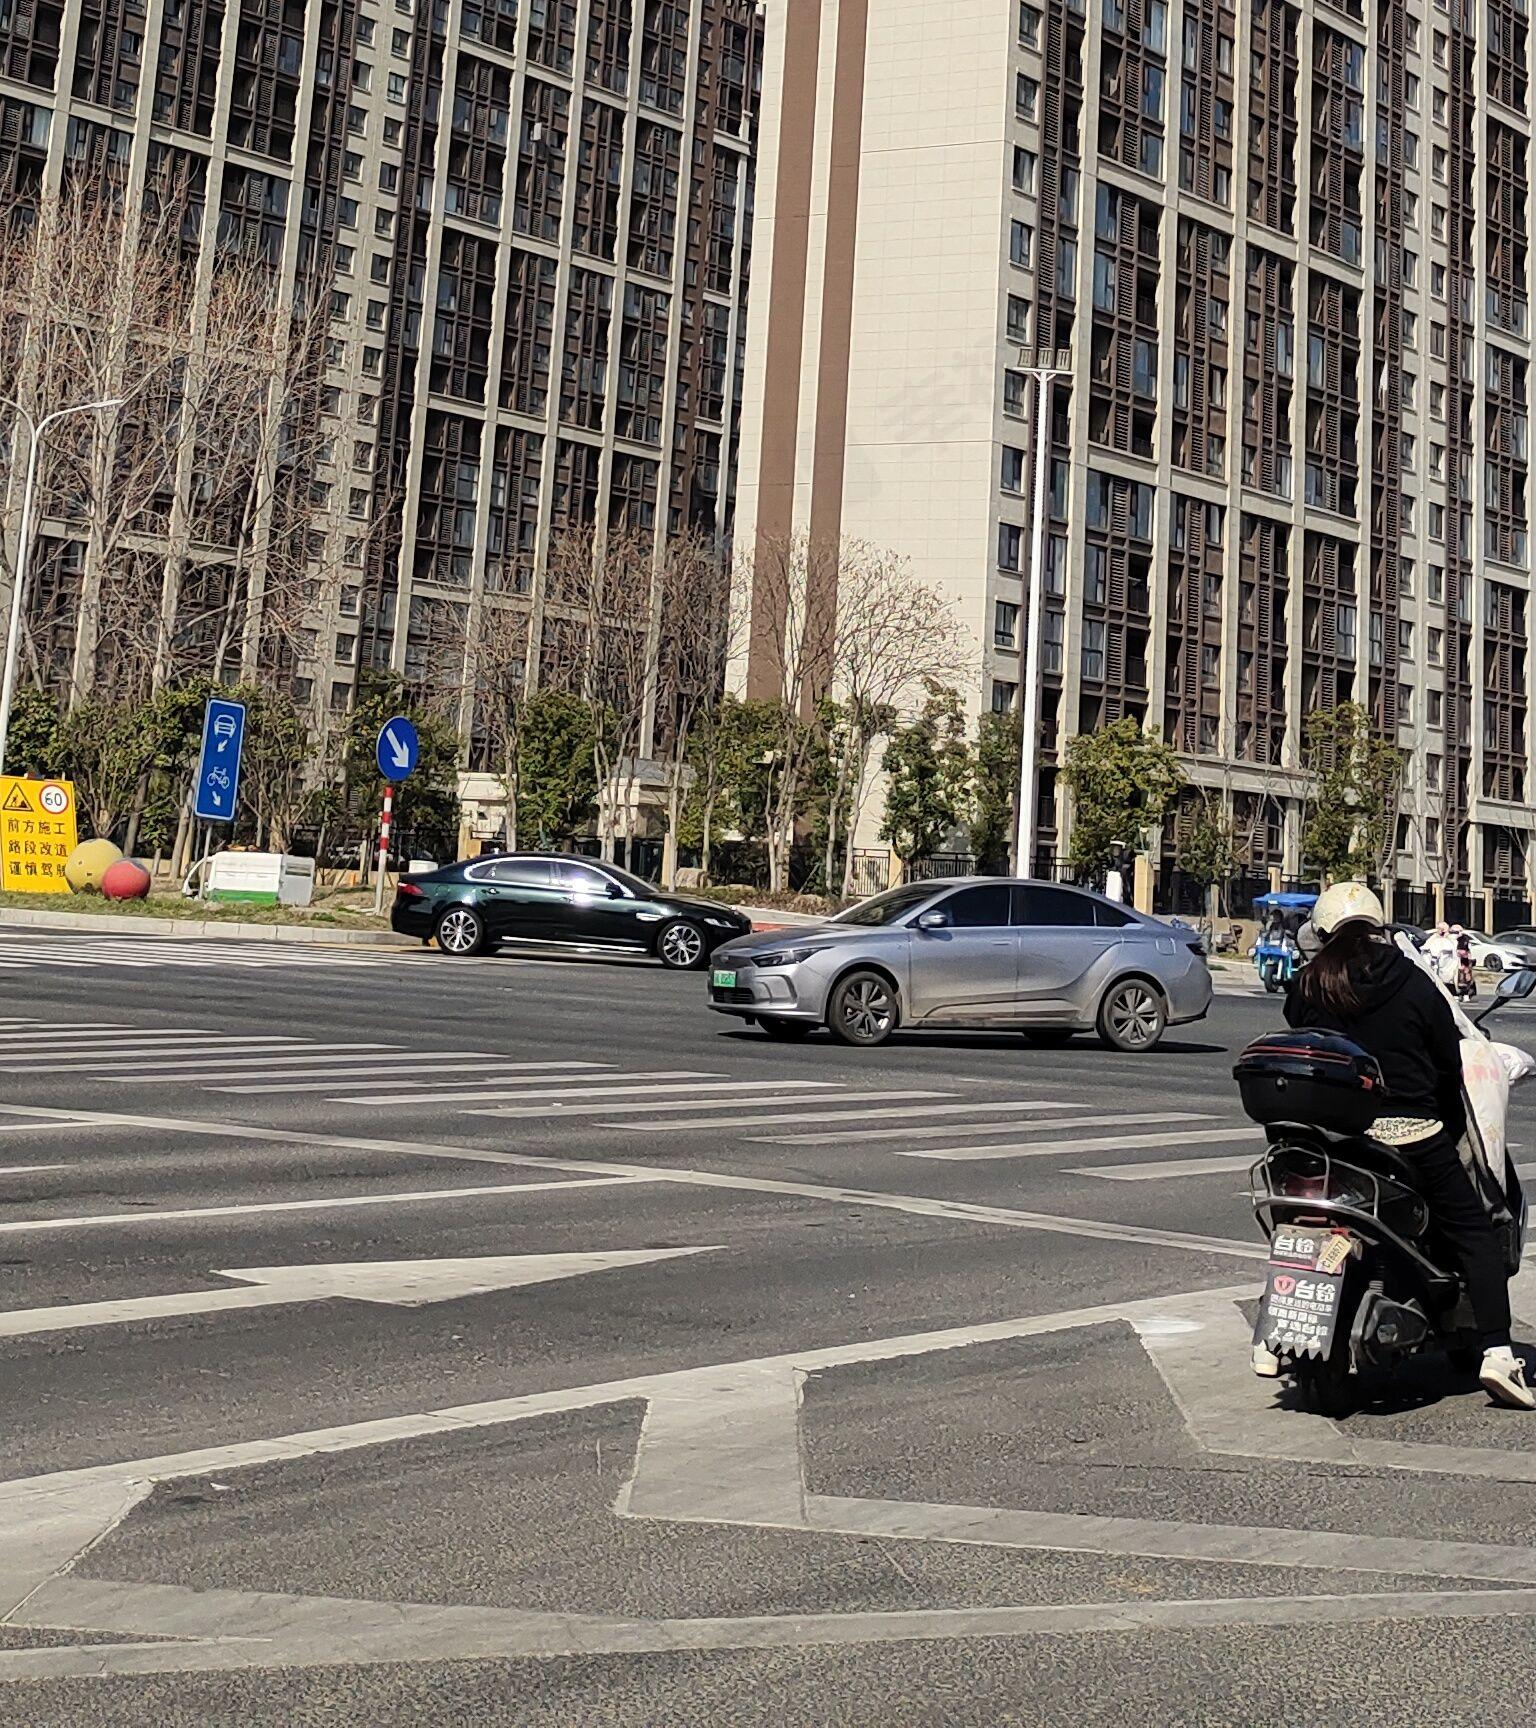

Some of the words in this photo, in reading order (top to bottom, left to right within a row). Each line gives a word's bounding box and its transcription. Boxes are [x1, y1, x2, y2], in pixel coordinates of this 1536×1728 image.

[44, 792, 63, 806] 60
[8, 818, 66, 835] 前方施工
[9, 839, 68, 857] 路段改道
[1275, 1234, 1315, 1254] 台铃
[1295, 1279, 1336, 1303] 台铃
